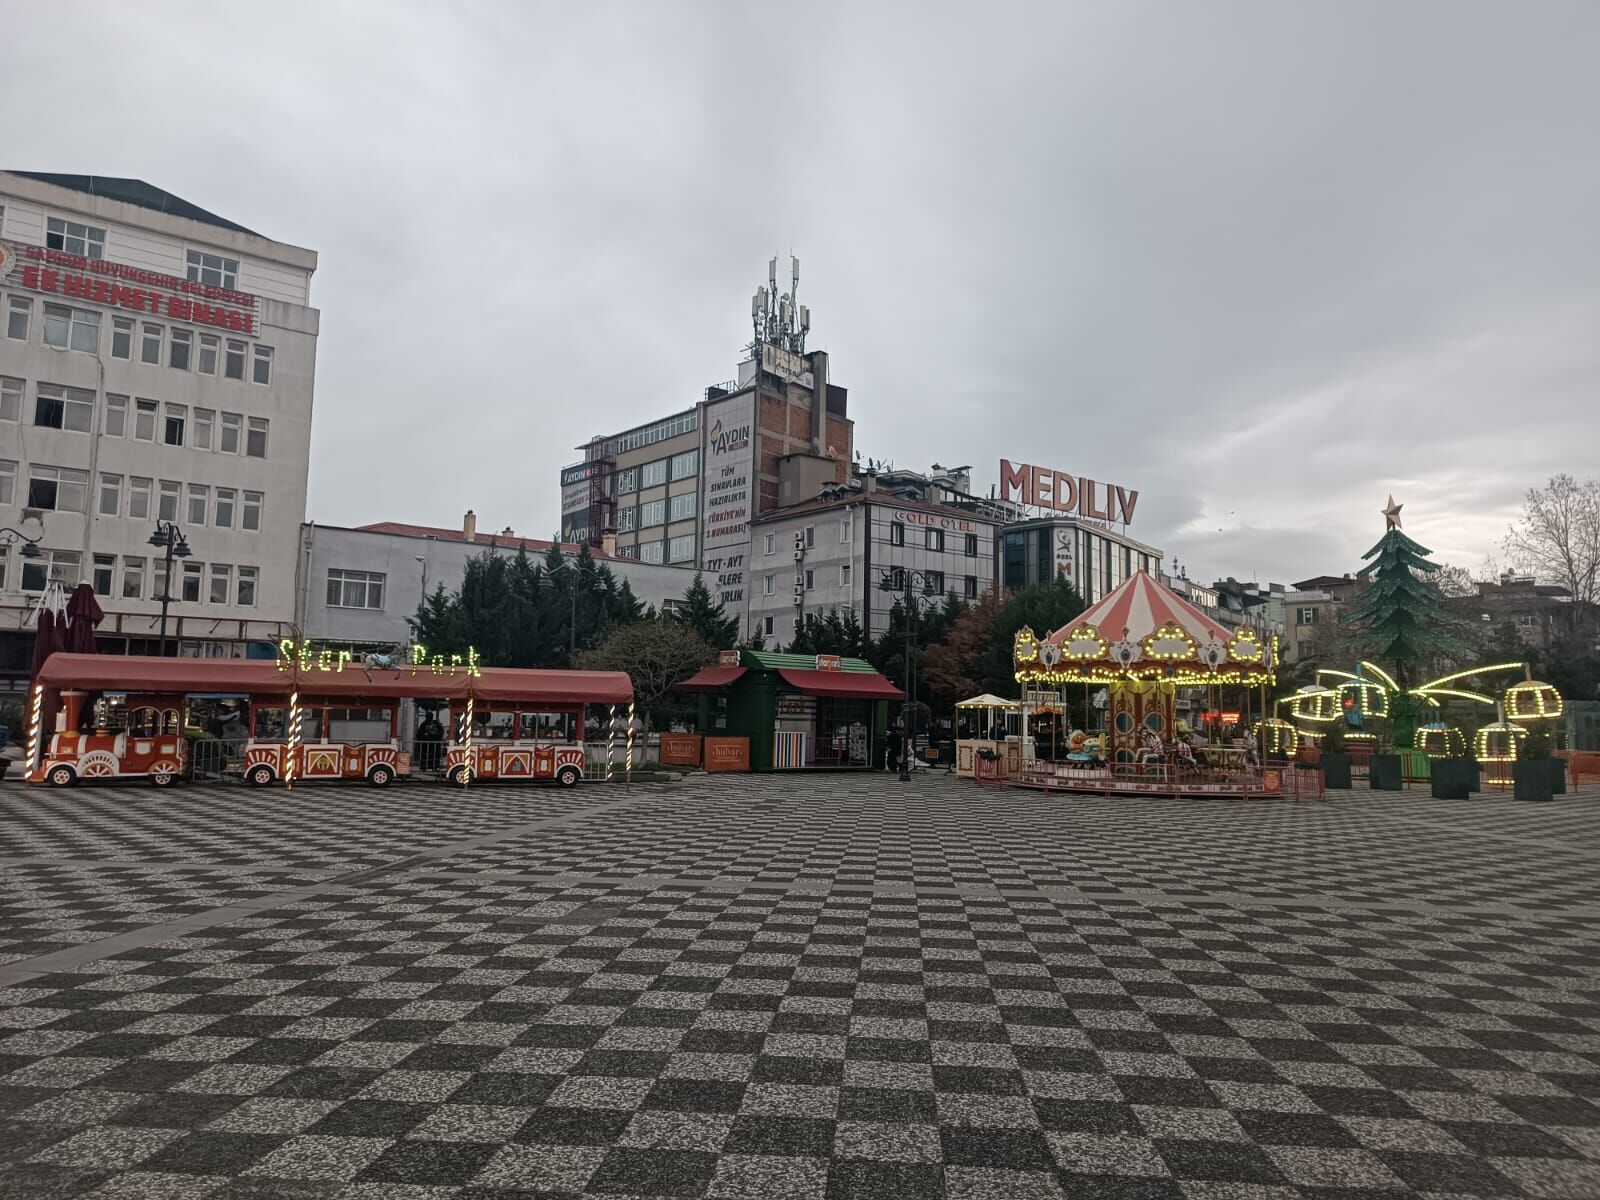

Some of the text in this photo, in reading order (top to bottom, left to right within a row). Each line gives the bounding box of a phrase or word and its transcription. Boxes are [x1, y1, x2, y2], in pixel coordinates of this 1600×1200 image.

[23, 264, 60, 293] EK
[721, 464, 735, 478] TÜM
[711, 476, 746, 492] SINAVLARA
[1000, 459, 1138, 525] MEDILIV
[708, 555, 744, 570] TYT AYT
